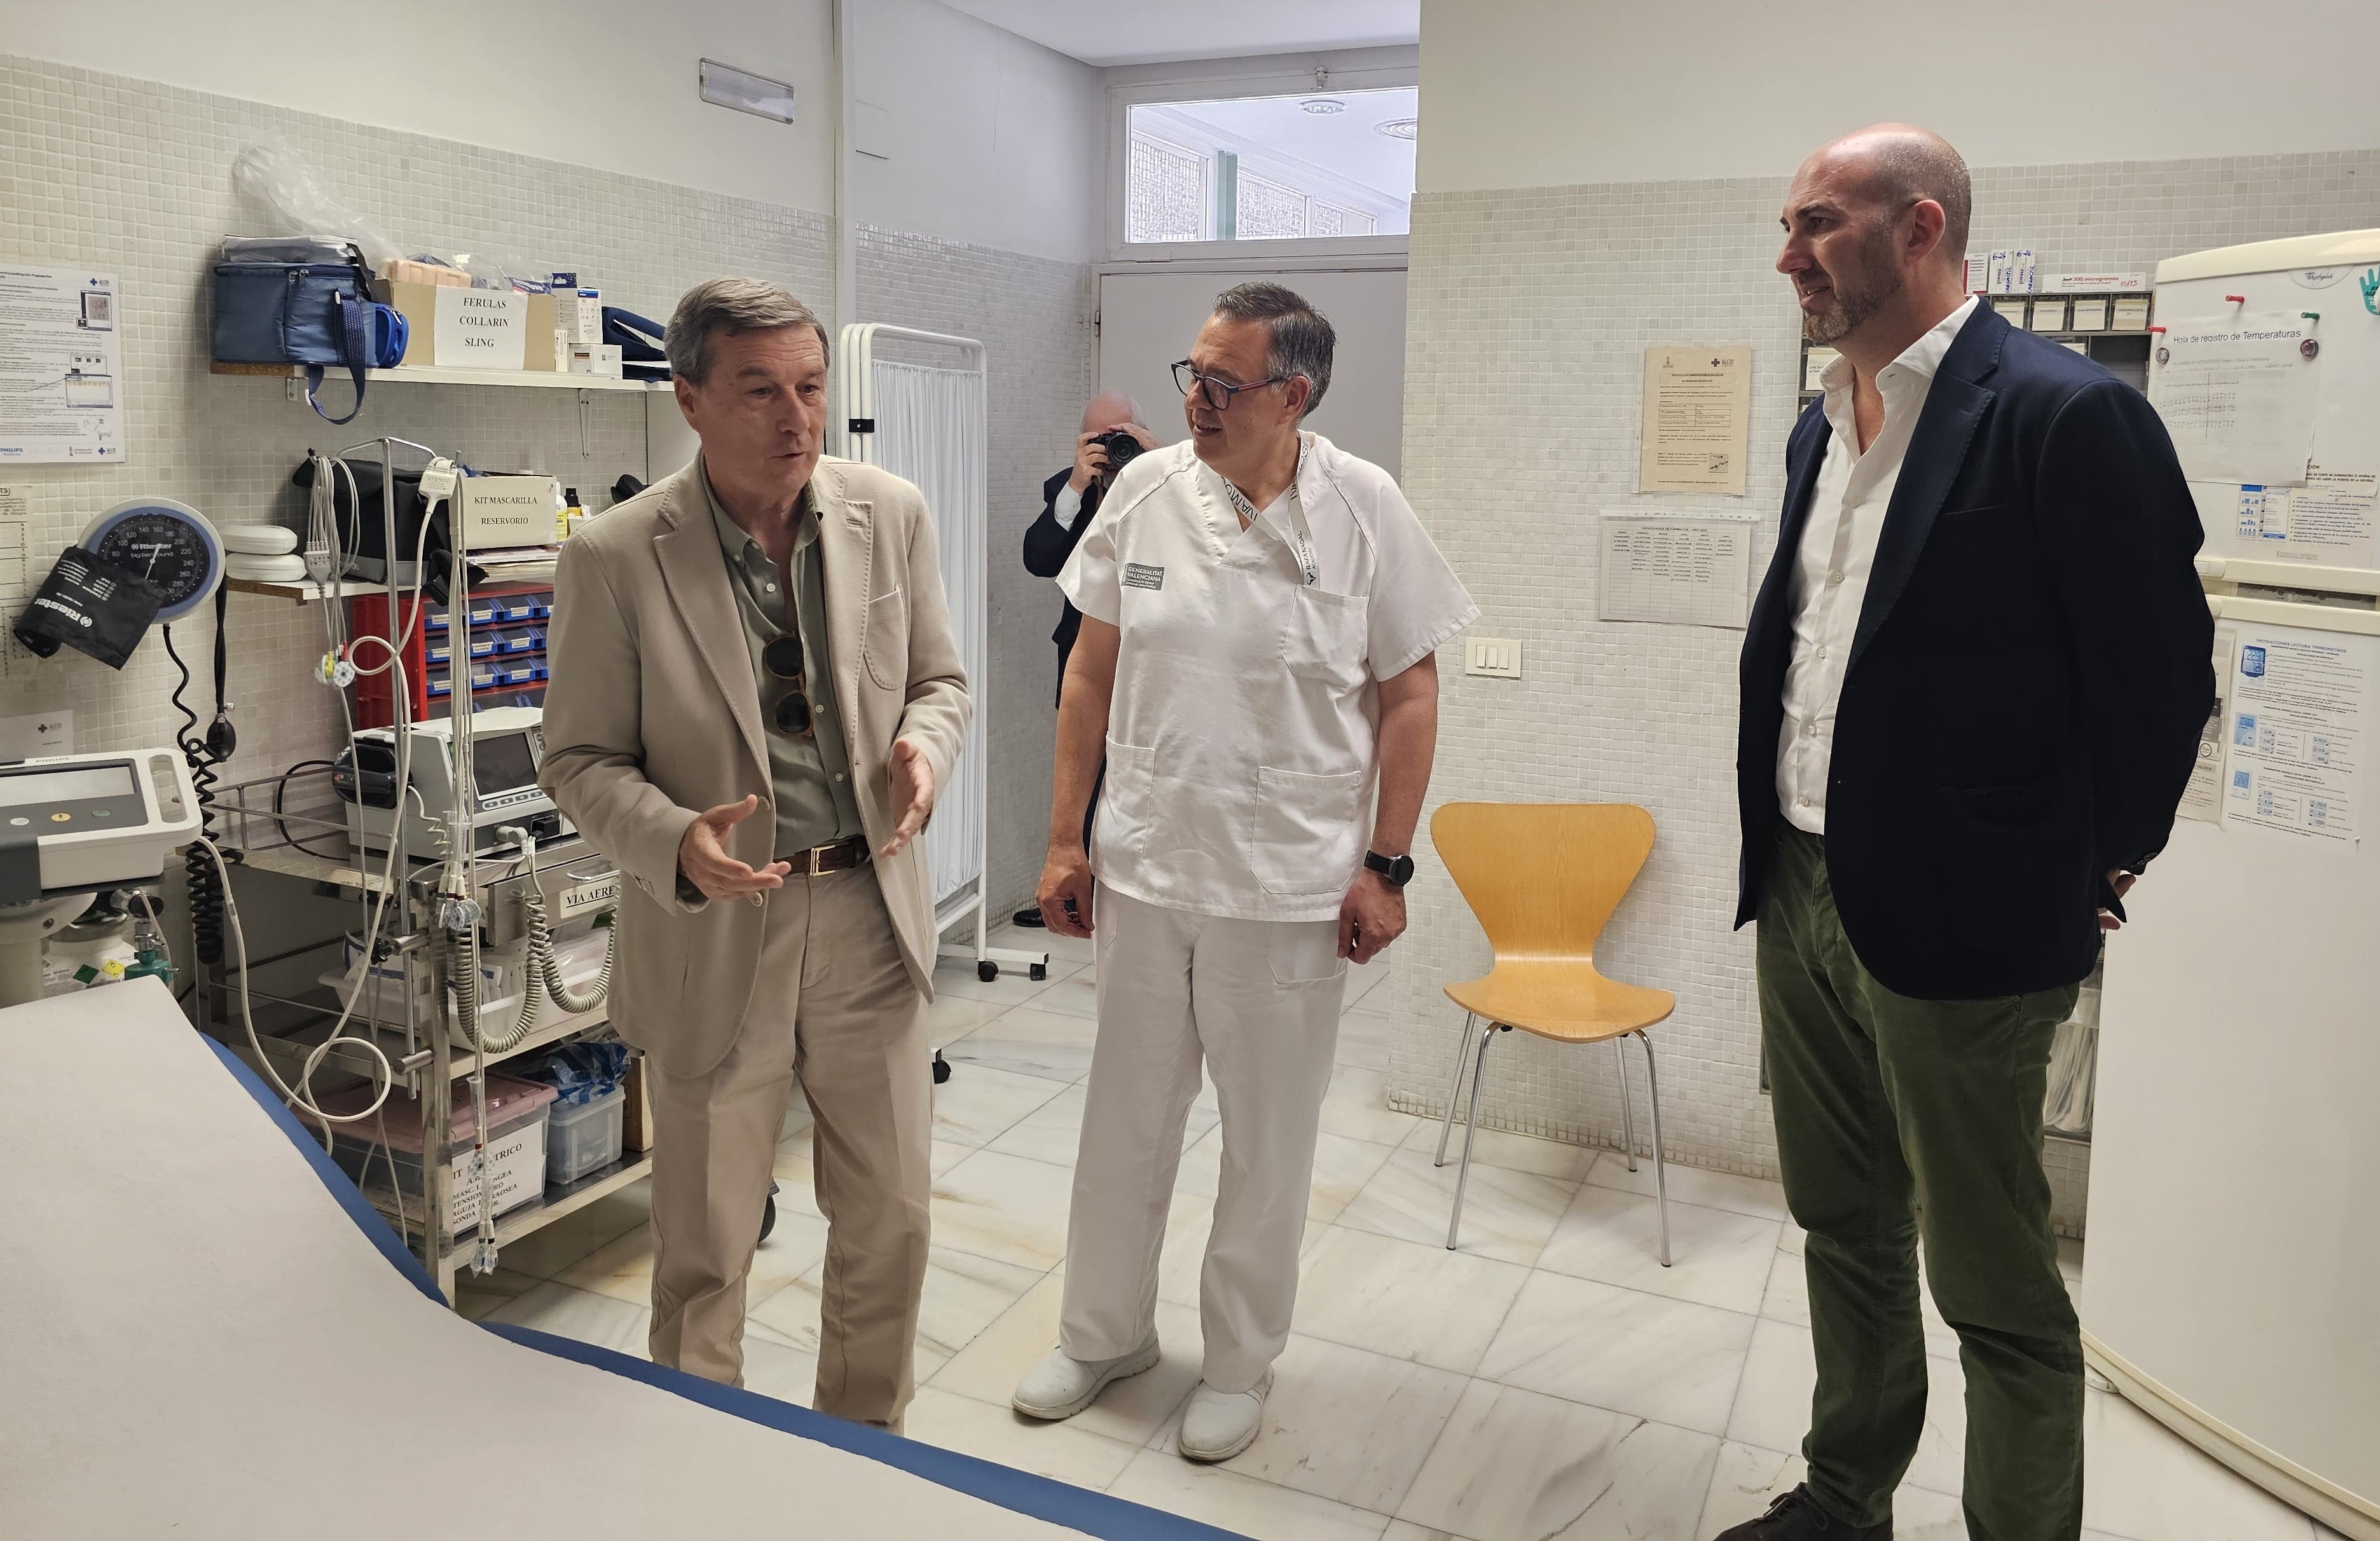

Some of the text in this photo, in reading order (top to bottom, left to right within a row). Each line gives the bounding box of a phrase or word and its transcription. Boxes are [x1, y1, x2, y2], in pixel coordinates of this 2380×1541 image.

[463, 298, 506, 309] FERULAS
[459, 315, 509, 327] COLLARIN
[2230, 332, 2241, 341] de
[2243, 330, 2301, 341] Temperaturas
[465, 337, 494, 348] SLING
[1298, 530, 1307, 552] NADAL
[1127, 572, 1160, 582] VALENCIANA
[1128, 566, 1163, 576] GENERALITAT
[34, 598, 81, 622] Riester
[567, 885, 615, 905] VIA AERE
[453, 1168, 463, 1180] IT
[453, 1202, 476, 1217] AGUJA
